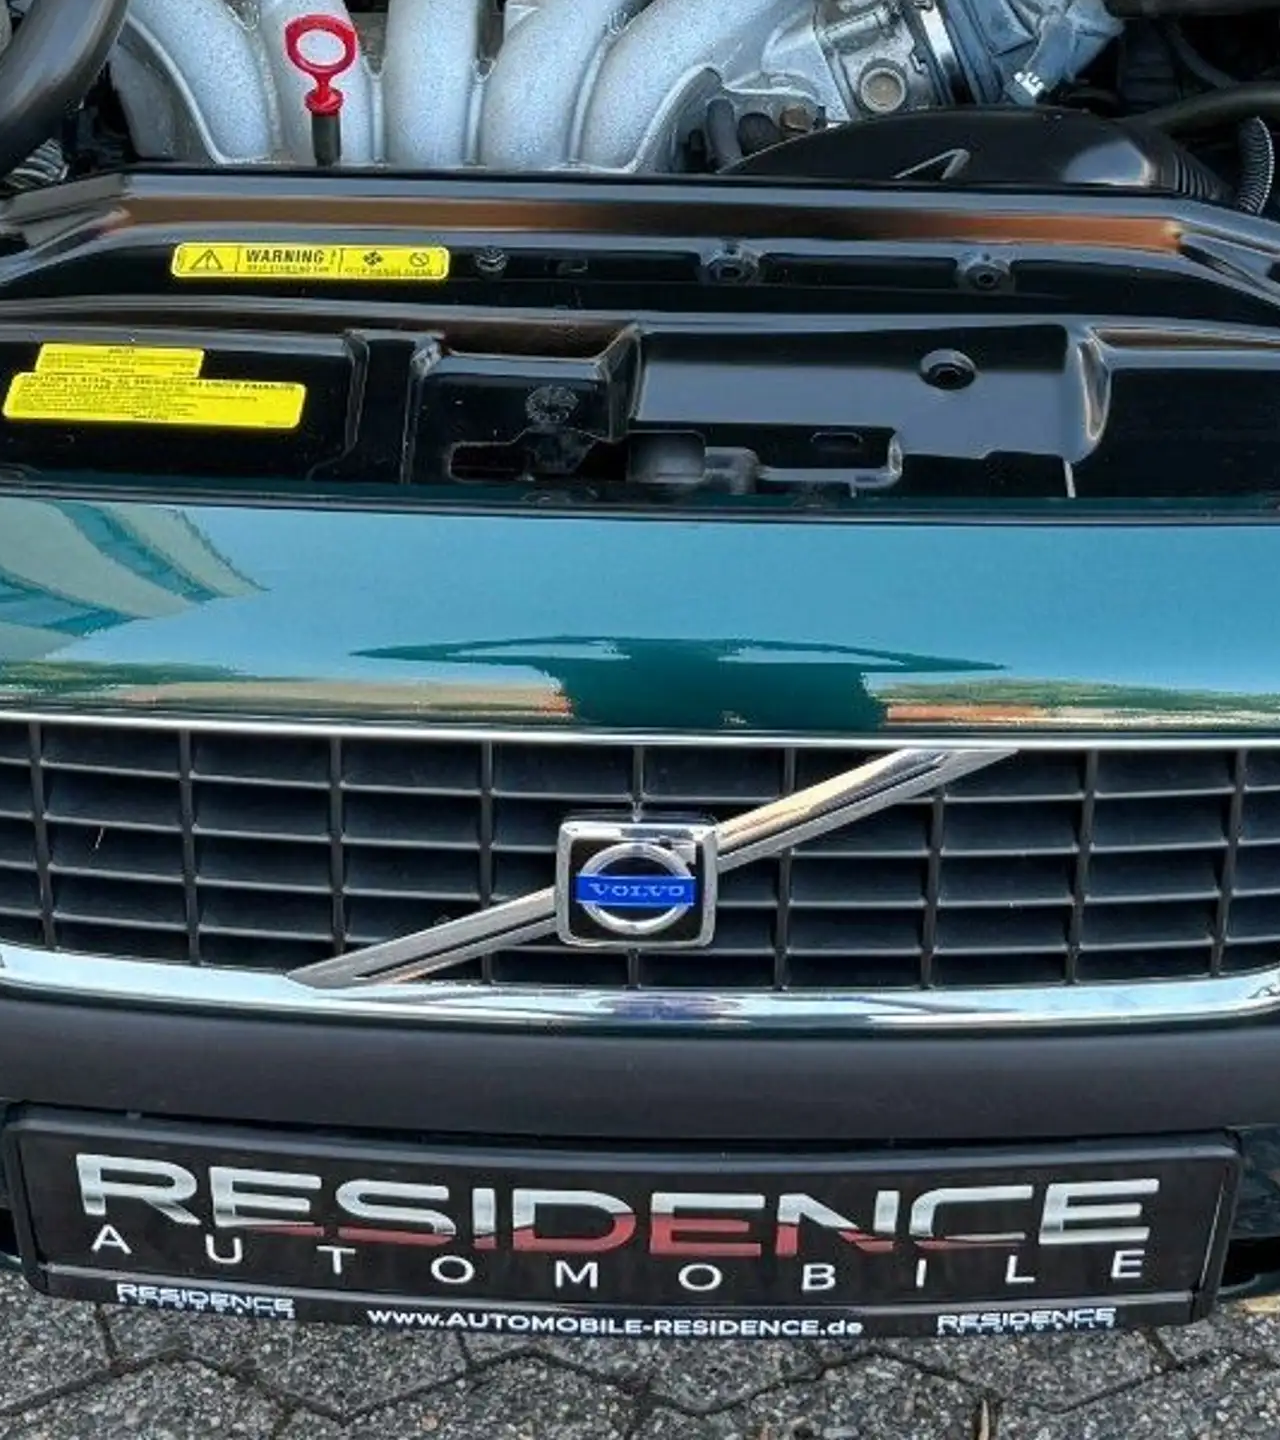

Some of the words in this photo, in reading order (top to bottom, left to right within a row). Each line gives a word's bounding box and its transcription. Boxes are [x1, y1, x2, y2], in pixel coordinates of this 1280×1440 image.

[246, 248, 325, 264] WARNING
[588, 882, 686, 897] VOLVO
[75, 1153, 1160, 1257] RESIDENCE
[91, 1223, 1146, 1292] AUTOMOBILE
[116, 1282, 295, 1312] RESIDENCE
[366, 1308, 864, 1337] www.AUTOMOBILE-RESIDENCE.de
[937, 1307, 1117, 1329] RESIDENCE
